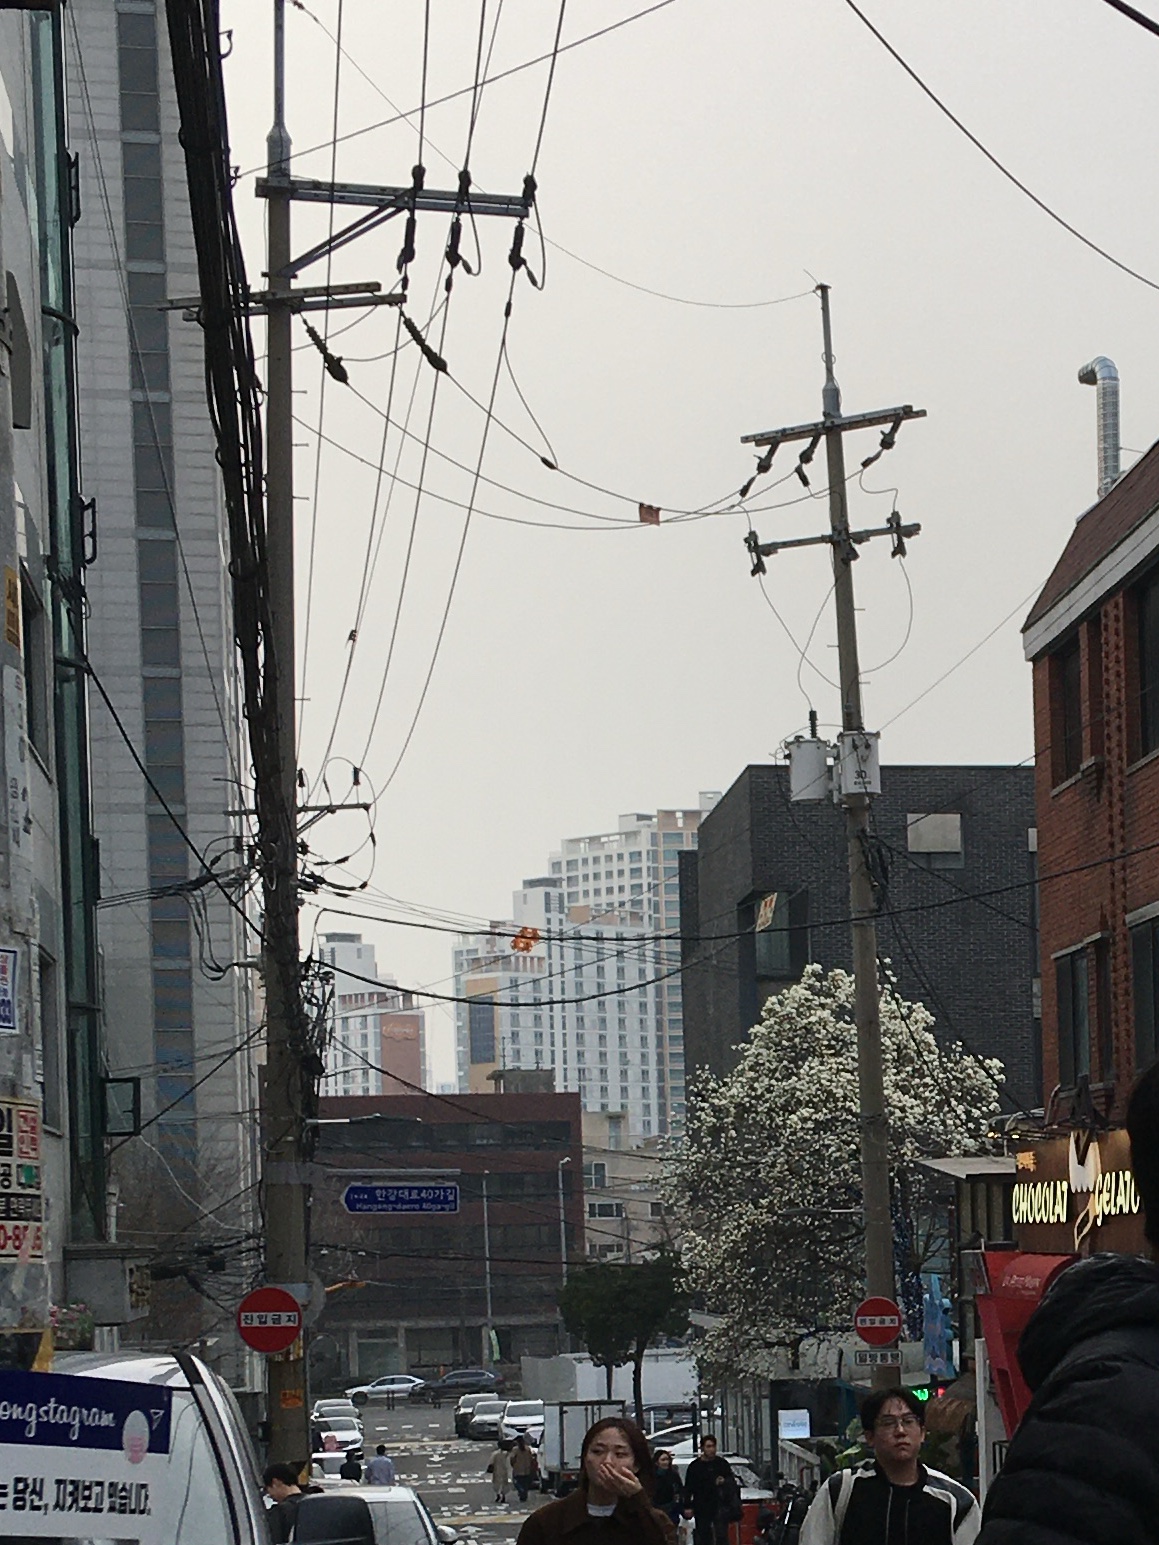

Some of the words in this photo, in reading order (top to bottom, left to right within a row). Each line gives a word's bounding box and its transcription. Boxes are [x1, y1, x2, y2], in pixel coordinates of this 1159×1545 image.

[375, 1188, 455, 1201] 한강대로40가길
[1012, 1181, 1069, 1224] CHOCOLAT
[243, 1313, 298, 1326] 진입금지
[13, 1476, 49, 1516] 당신,
[53, 1478, 105, 1514] 지켜보고
[107, 1480, 152, 1516] 있습니다.
